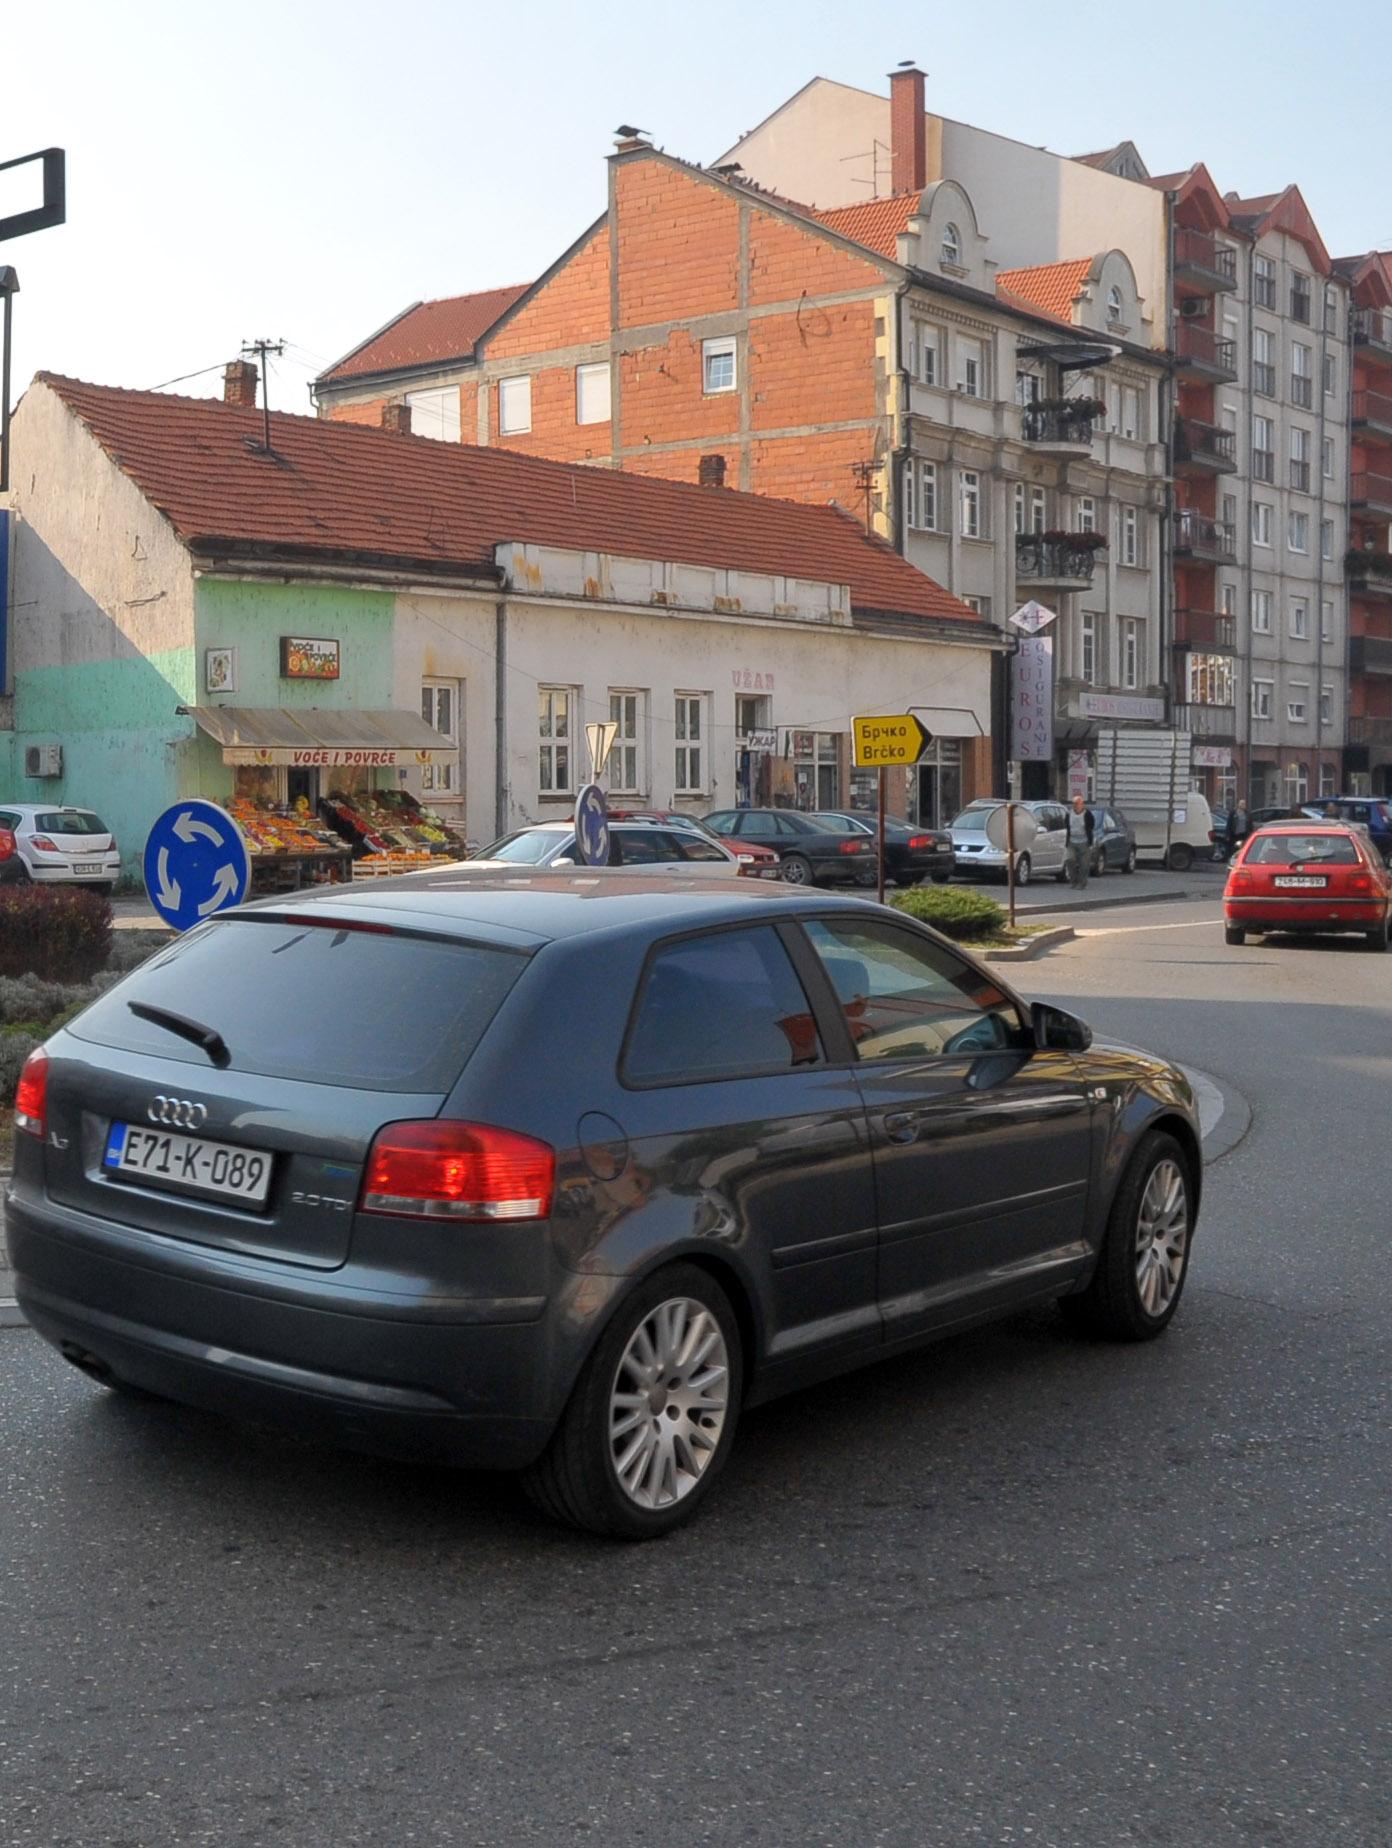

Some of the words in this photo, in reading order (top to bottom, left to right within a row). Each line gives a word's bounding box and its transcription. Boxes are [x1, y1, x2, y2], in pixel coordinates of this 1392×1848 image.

[1019, 642, 1032, 756] EUROS
[861, 725, 907, 741] Брчко
[863, 745, 906, 760] Brčko
[123, 1130, 264, 1193] E71-K-089
